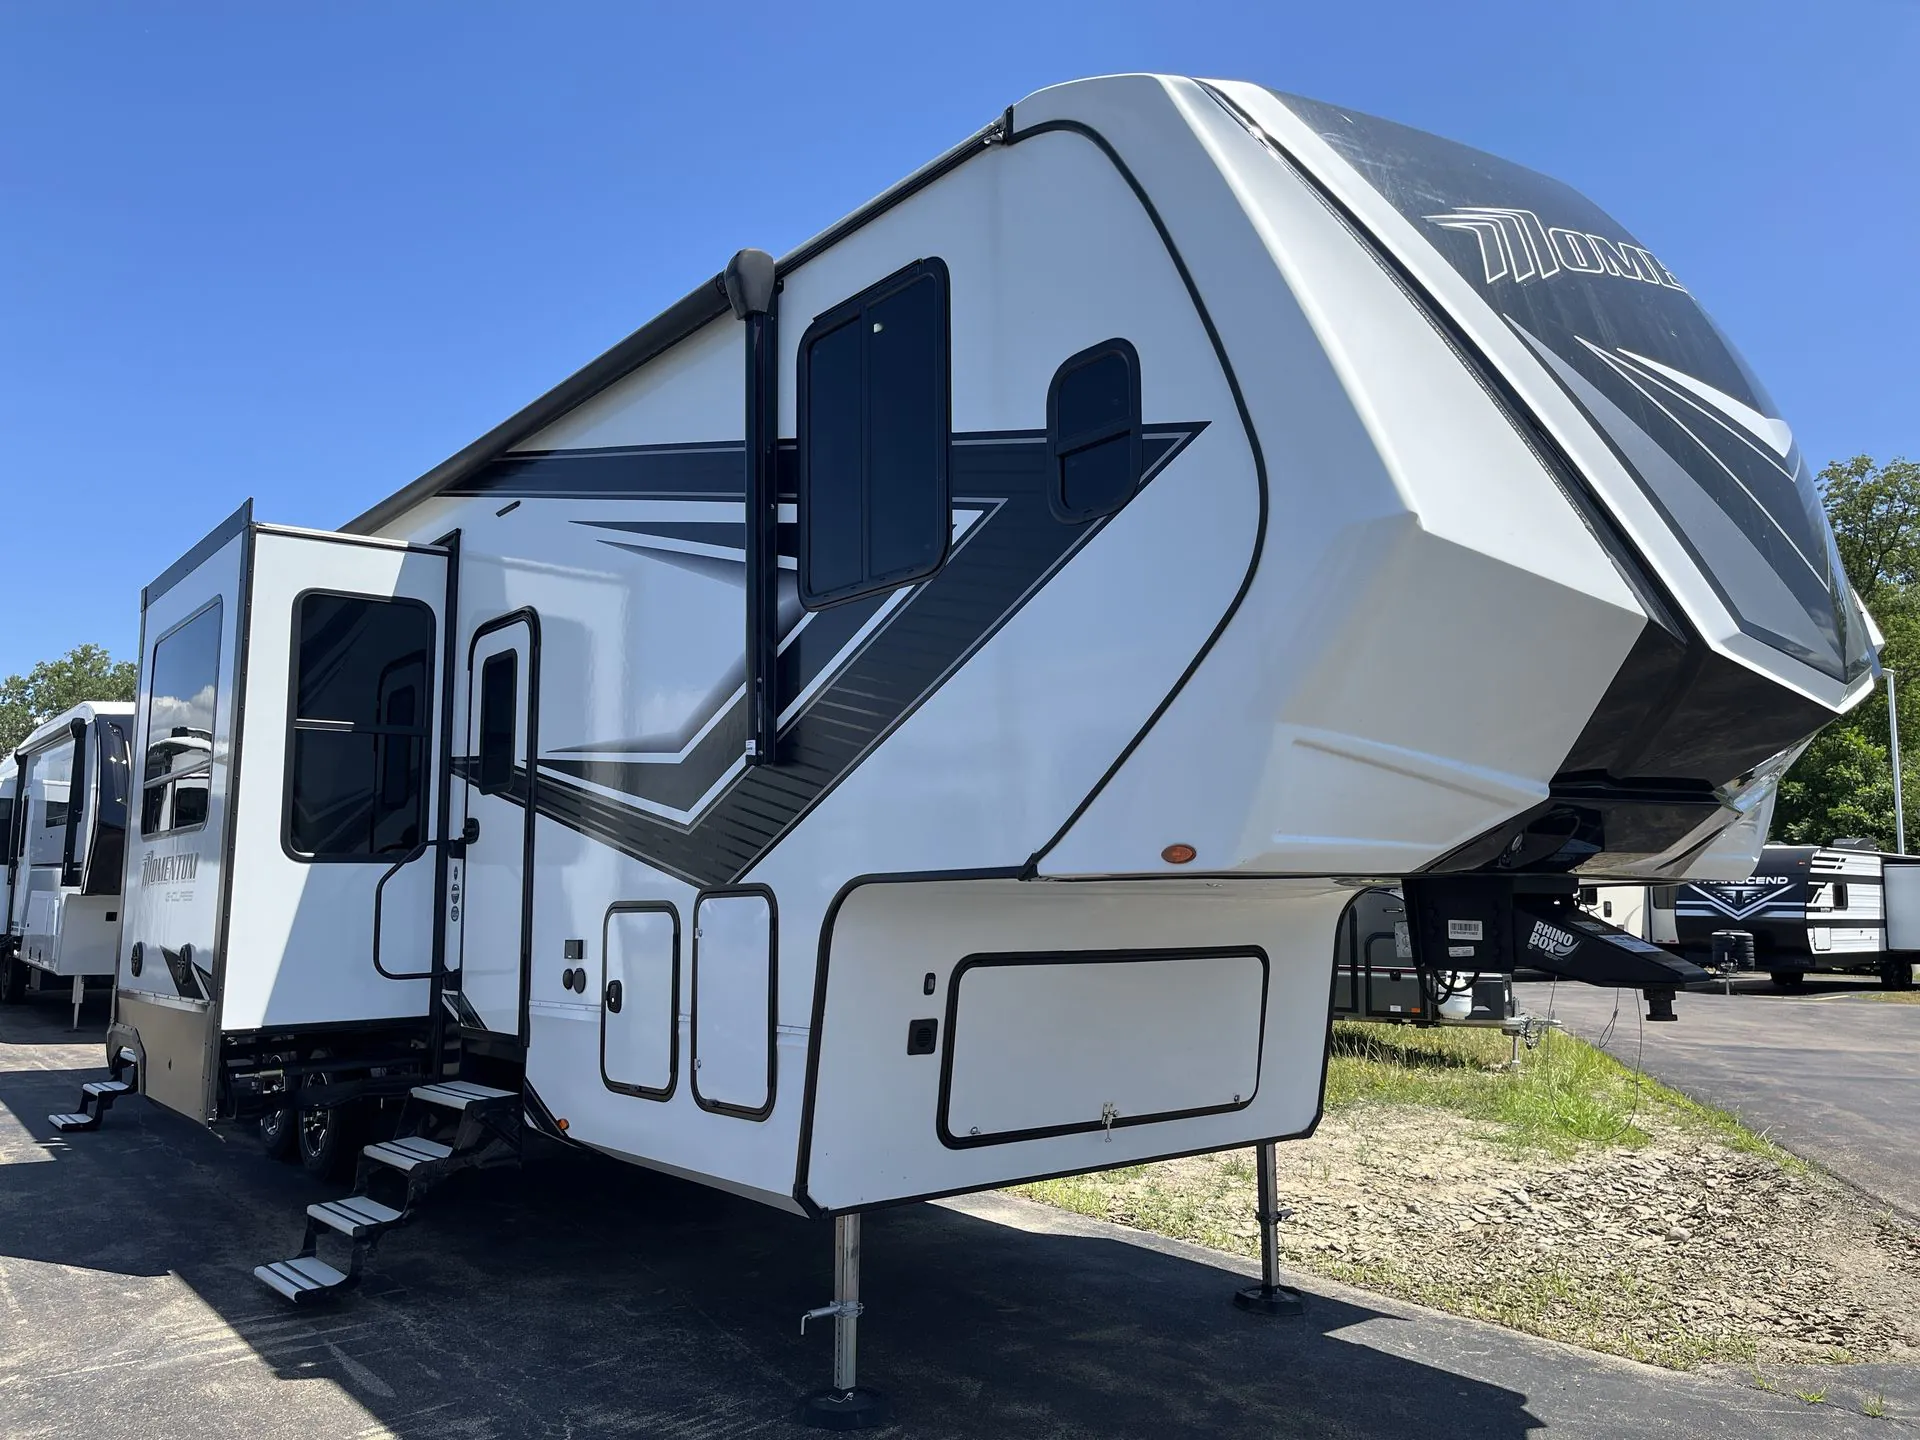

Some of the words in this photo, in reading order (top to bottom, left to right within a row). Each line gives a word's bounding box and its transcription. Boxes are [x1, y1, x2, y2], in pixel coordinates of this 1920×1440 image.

[142, 850, 200, 887] MOMENTUM
[1529, 931, 1558, 953] BOX
[1533, 920, 1574, 946] RHINO
